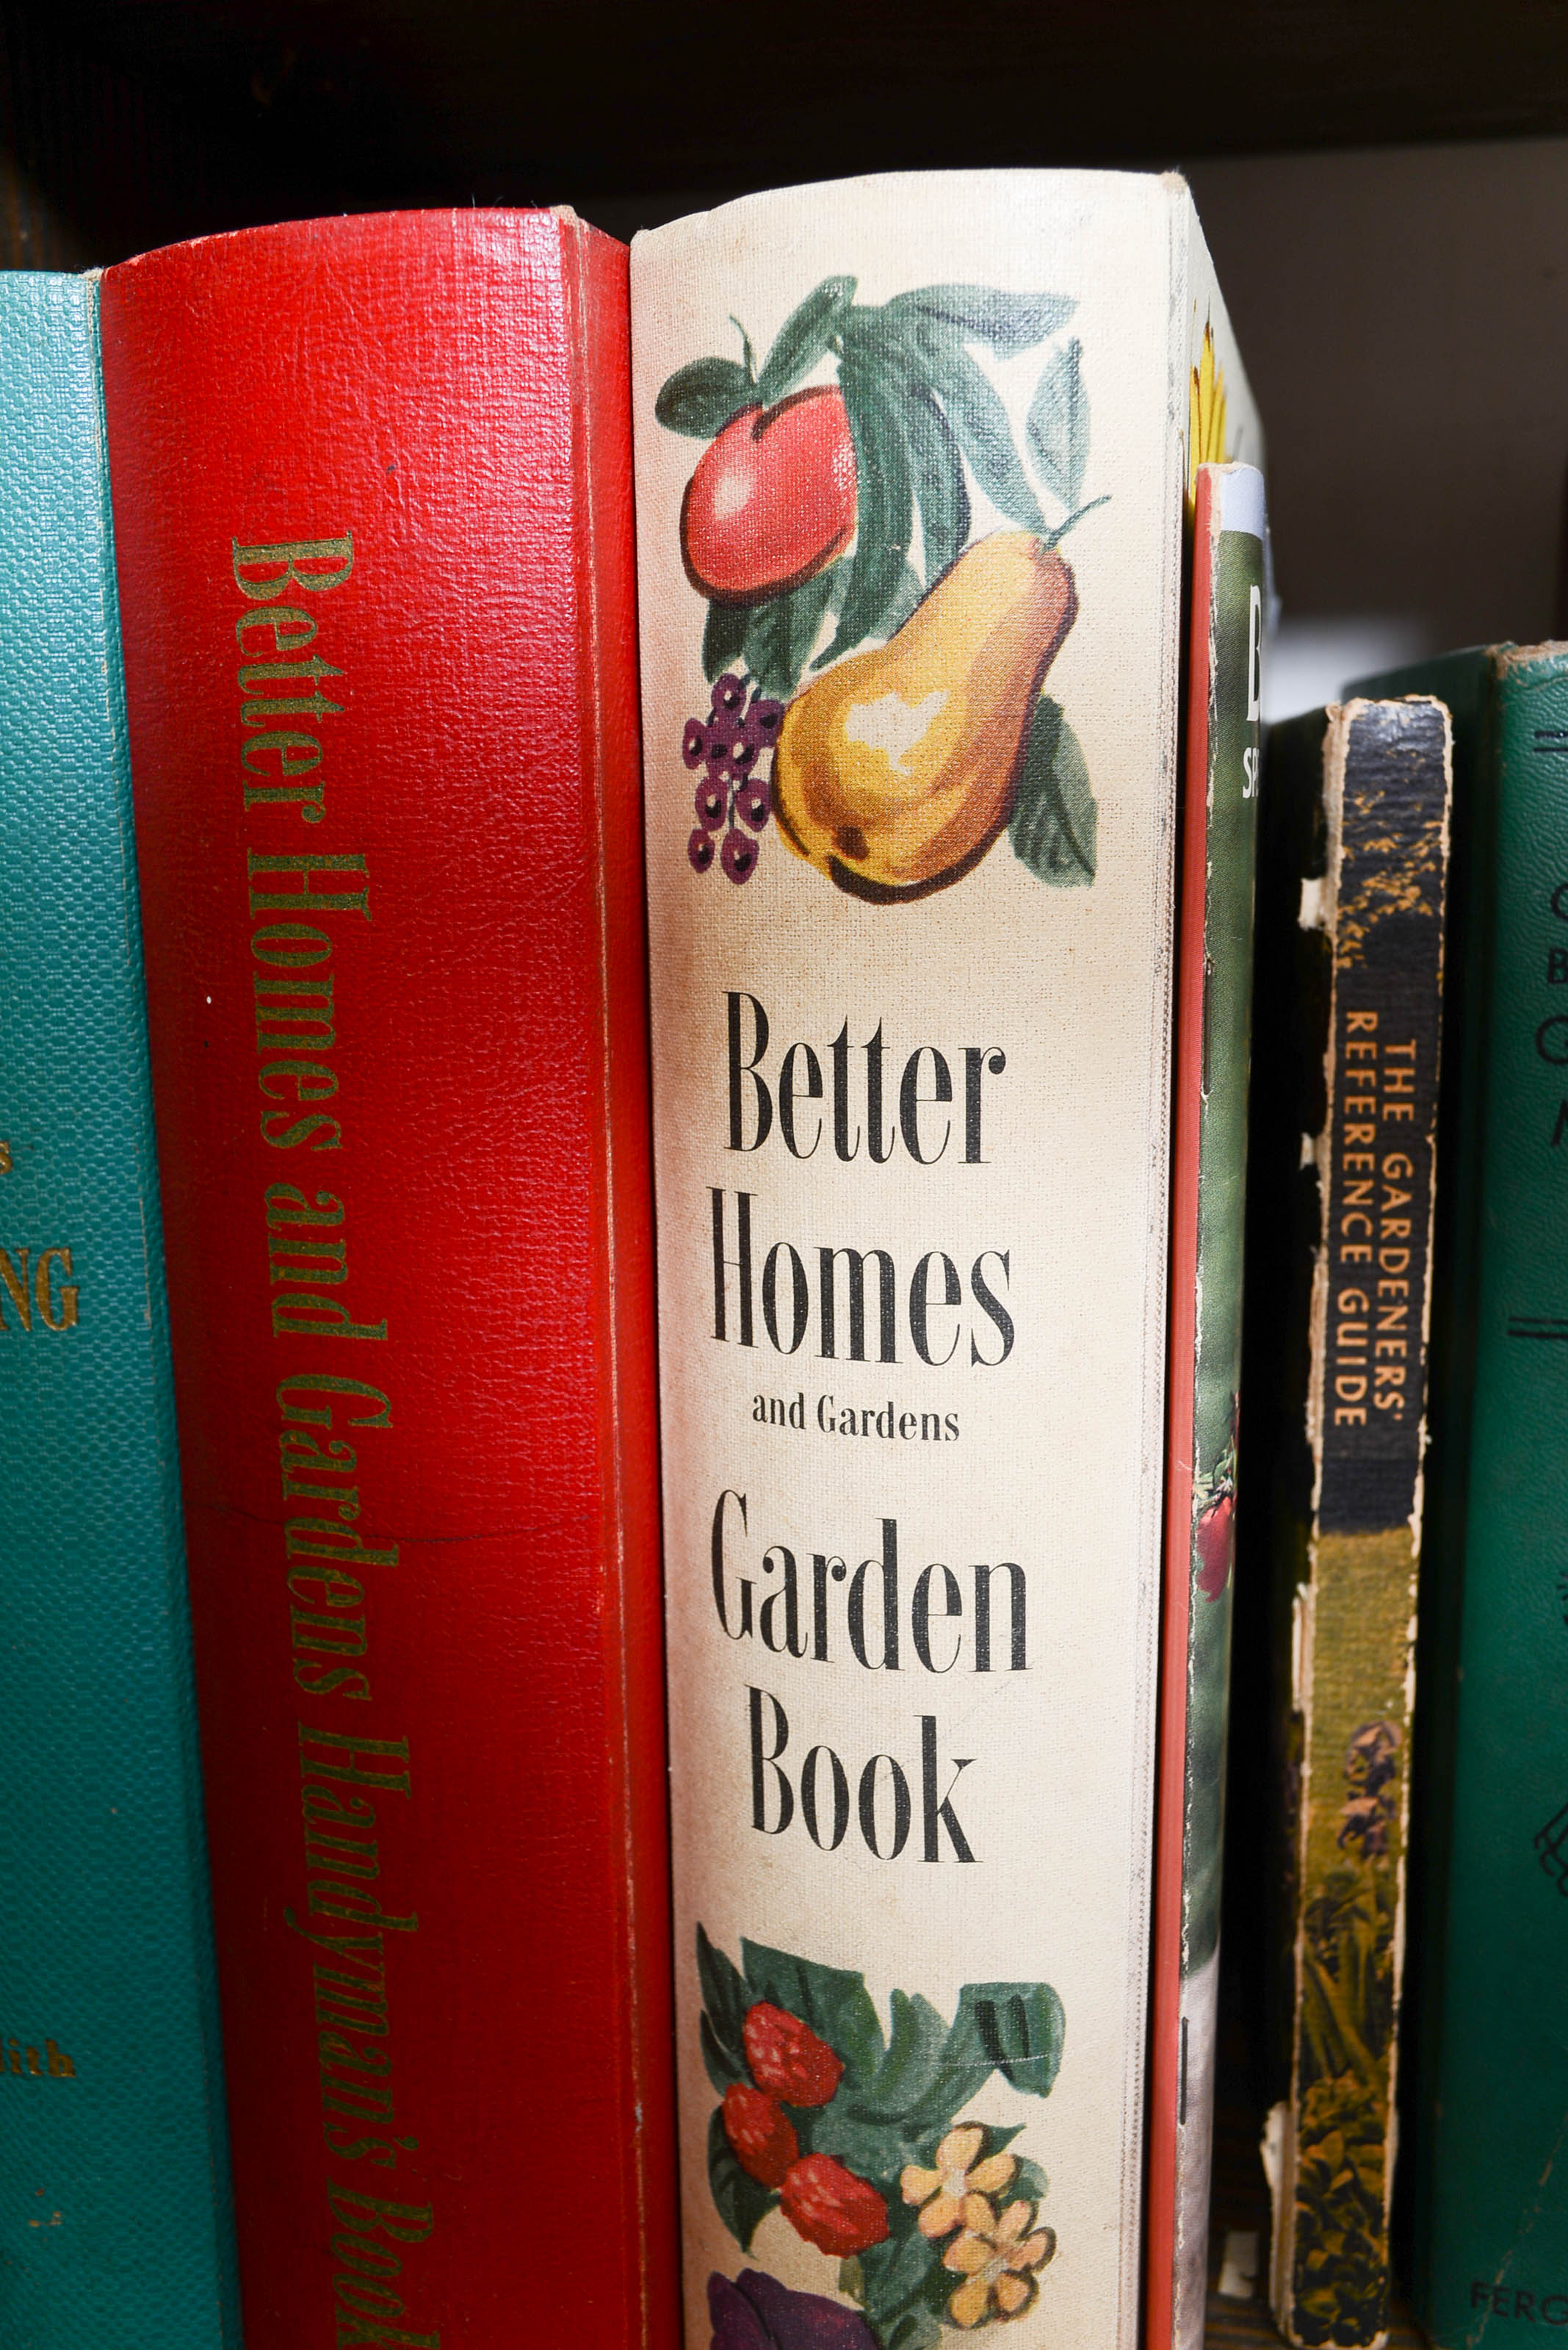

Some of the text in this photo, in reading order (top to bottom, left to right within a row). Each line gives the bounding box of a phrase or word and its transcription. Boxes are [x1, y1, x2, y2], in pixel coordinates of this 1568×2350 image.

[231, 530, 355, 823] Better
[246, 847, 372, 1152] Homes
[722, 990, 1007, 1165] Better
[1382, 1038, 1417, 1122] THE
[264, 1181, 389, 1341] and
[706, 1185, 1016, 1368] Homes
[1334, 1010, 1379, 1427] REFERENCE GUIDE
[752, 1391, 960, 1442] and Gardens
[275, 1373, 400, 1702] Gardens
[711, 1488, 1033, 1673] Garden
[744, 1683, 983, 1864] Book
[283, 1718, 419, 2169] Handyman's
